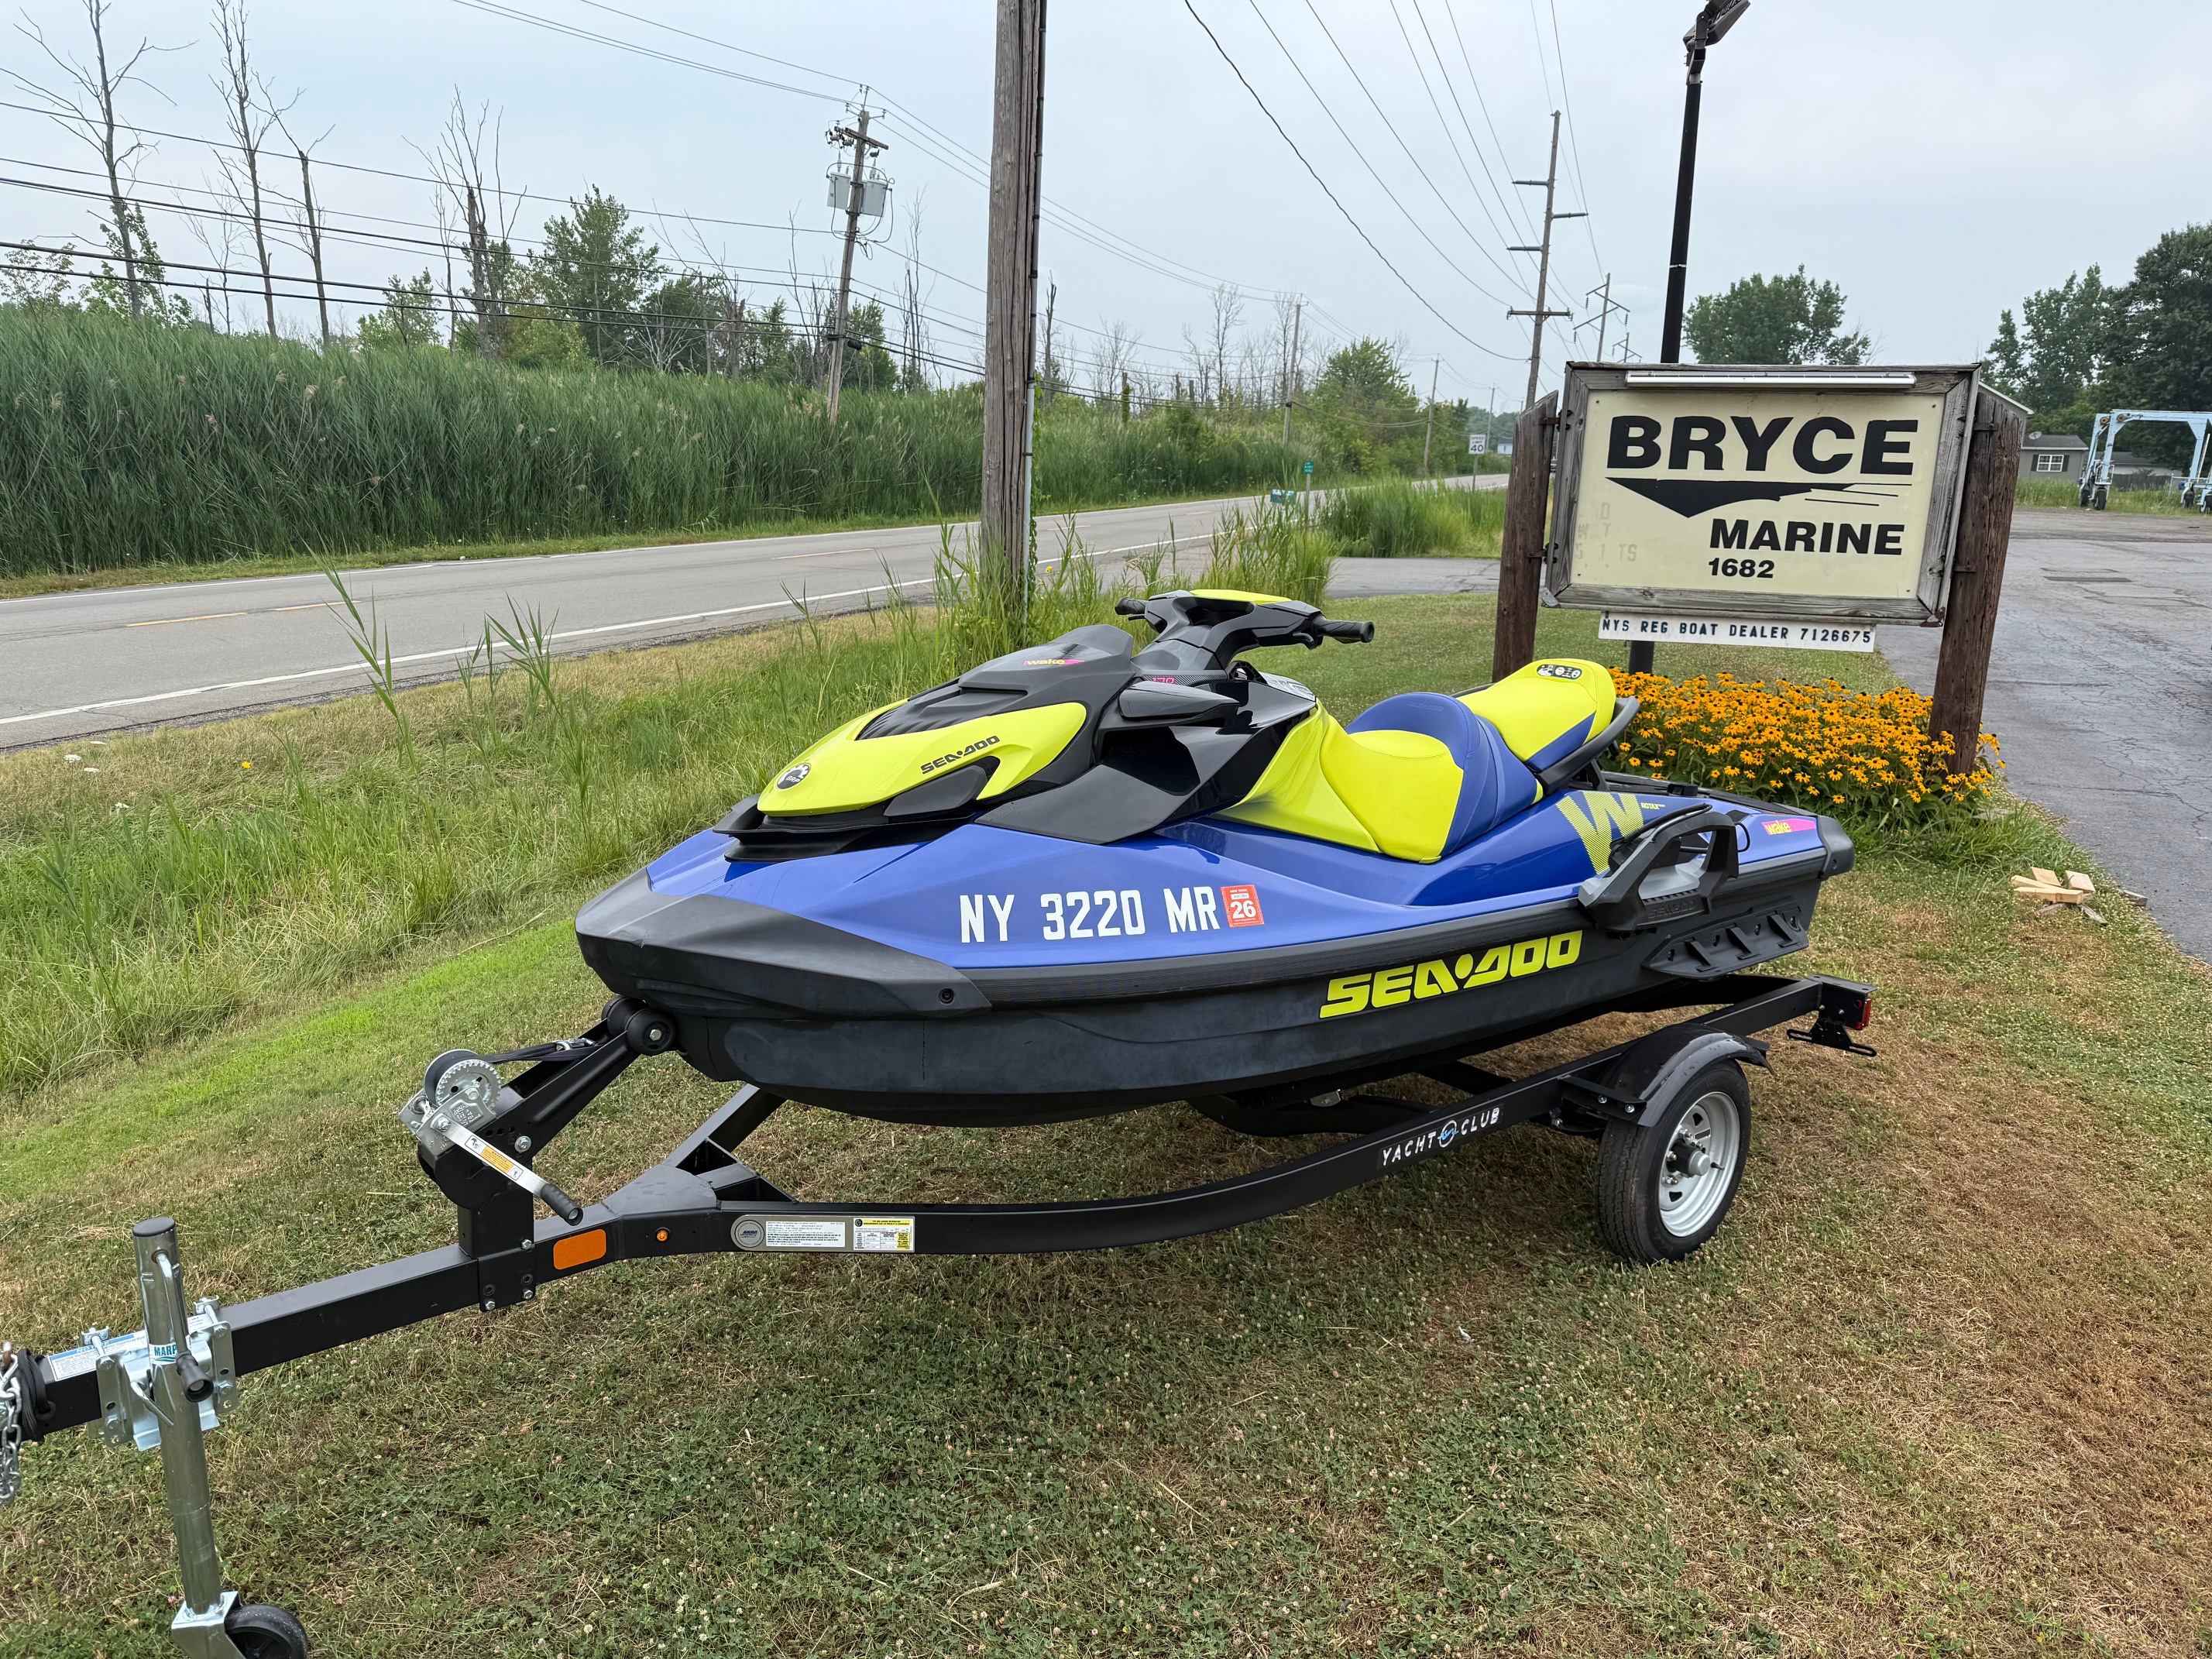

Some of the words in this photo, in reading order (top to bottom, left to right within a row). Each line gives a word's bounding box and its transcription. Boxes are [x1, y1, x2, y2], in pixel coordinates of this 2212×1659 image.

[1470, 444, 1484, 452] 40
[1607, 416, 1918, 475] BRYCE
[1709, 518, 1905, 555] MARINE
[1708, 558, 1775, 579] 1682
[1602, 619, 1630, 631] NYS
[1640, 621, 1668, 633] REG
[1679, 623, 1718, 635] BOAT
[1729, 624, 1789, 639] DEALER
[1800, 628, 1870, 643] 7126675
[1764, 819, 1792, 836] wake
[959, 894, 1015, 943] NY
[1040, 889, 1146, 941] 3220
[1163, 886, 1221, 933] MR
[1230, 899, 1256, 919] 26
[1382, 1131, 1437, 1166] YACHT
[1461, 1107, 1500, 1136] CLUB
